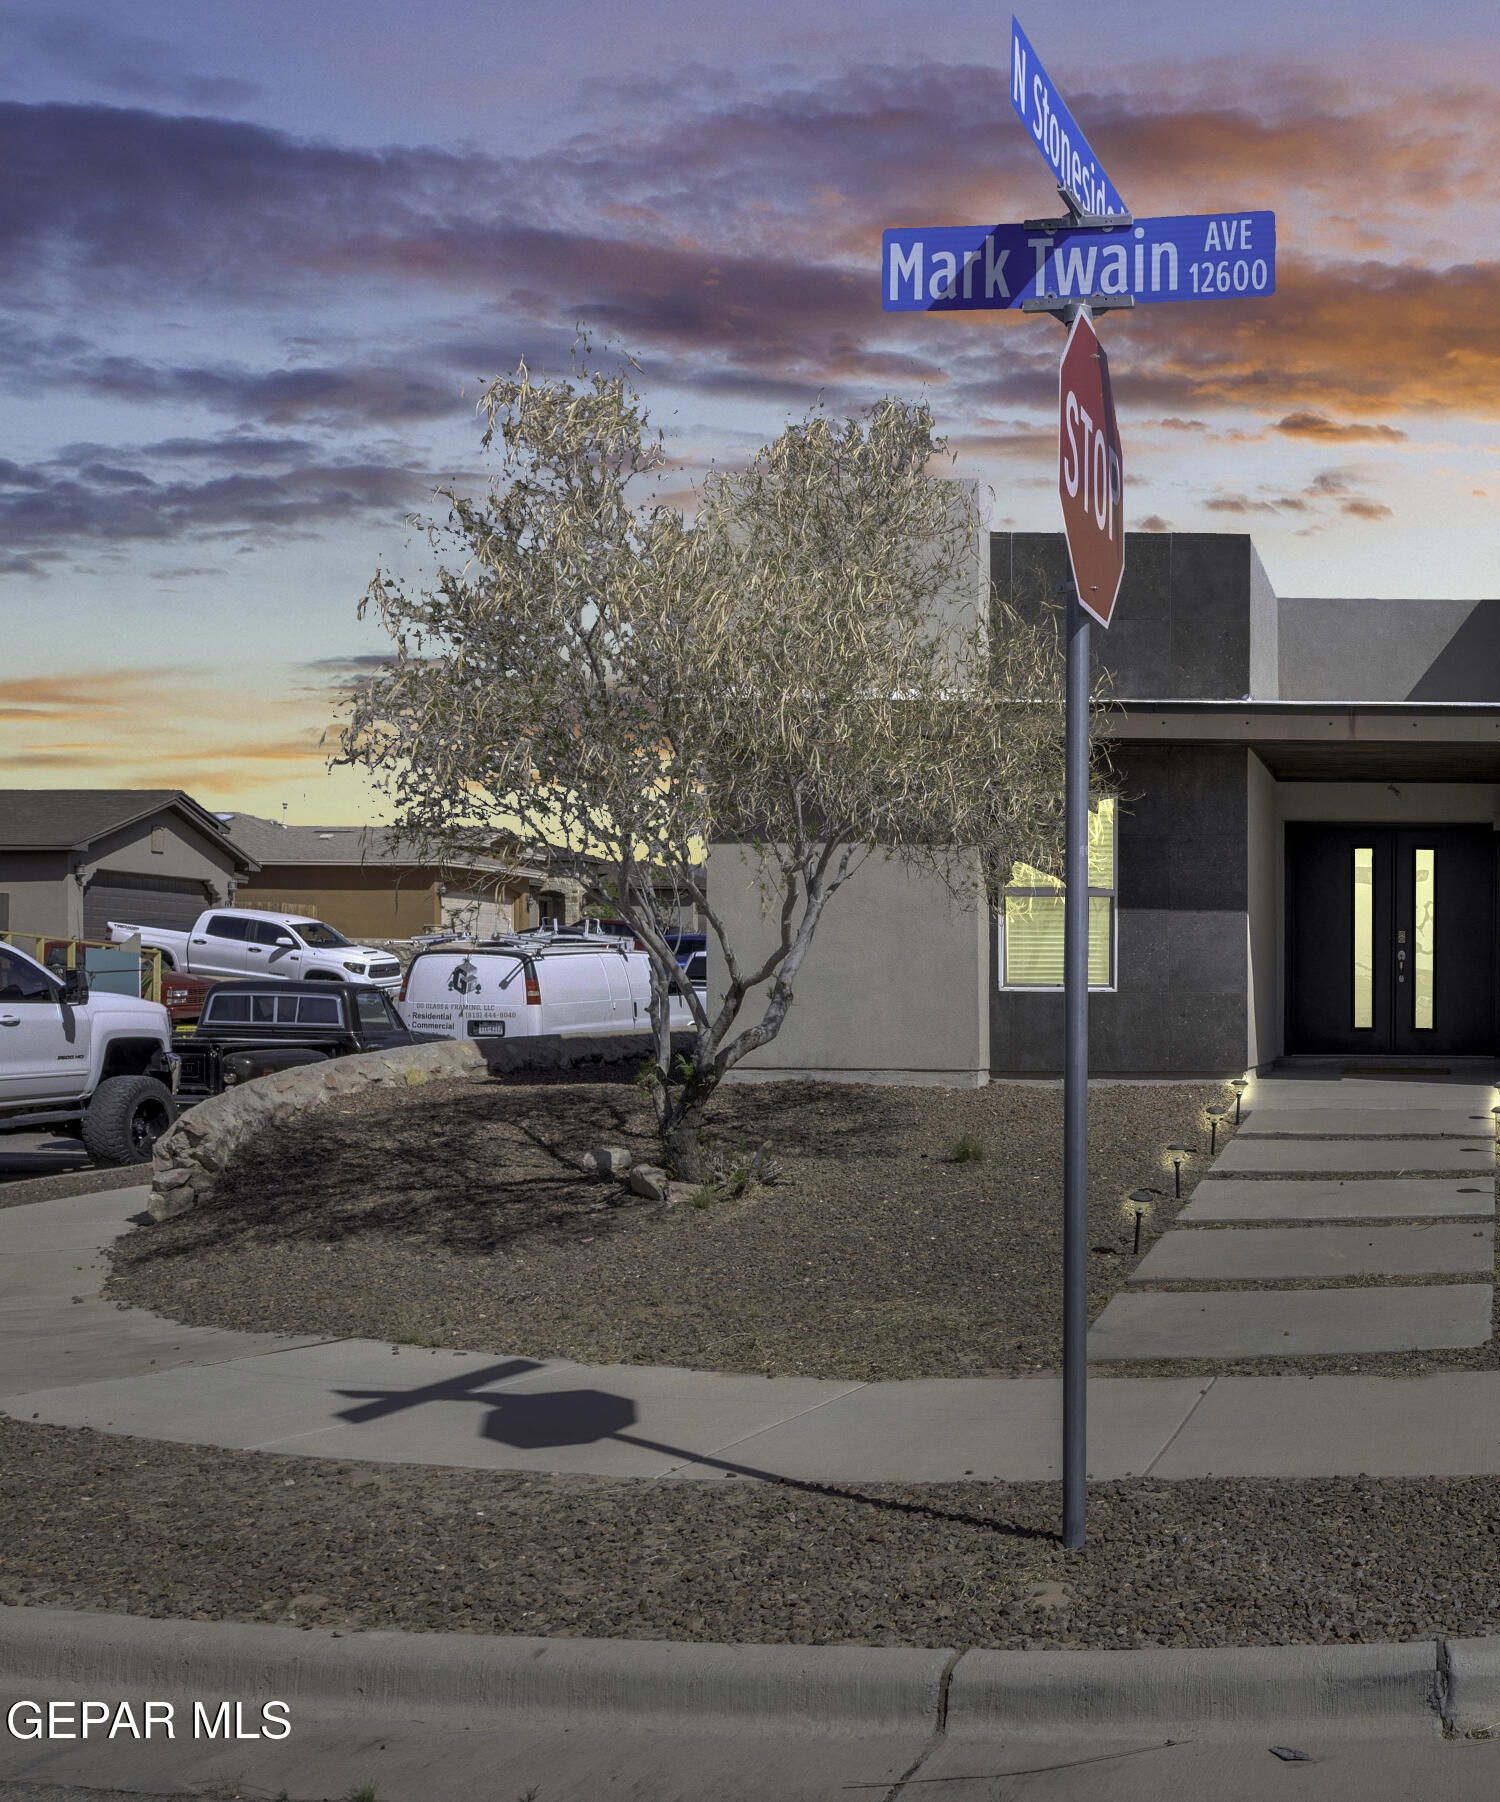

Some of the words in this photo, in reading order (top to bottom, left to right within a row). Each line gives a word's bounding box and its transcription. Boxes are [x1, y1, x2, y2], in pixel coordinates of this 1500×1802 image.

[1013, 35, 1027, 116] N
[1033, 73, 1115, 216] Stonesid
[1204, 219, 1253, 253] AVE
[889, 234, 1011, 301] Mark
[1028, 227, 1179, 298] Twain
[1189, 258, 1268, 294] 12600
[1064, 390, 1121, 542] STOP
[411, 1021, 455, 1030] Commercial
[412, 1011, 452, 1021] Residential
